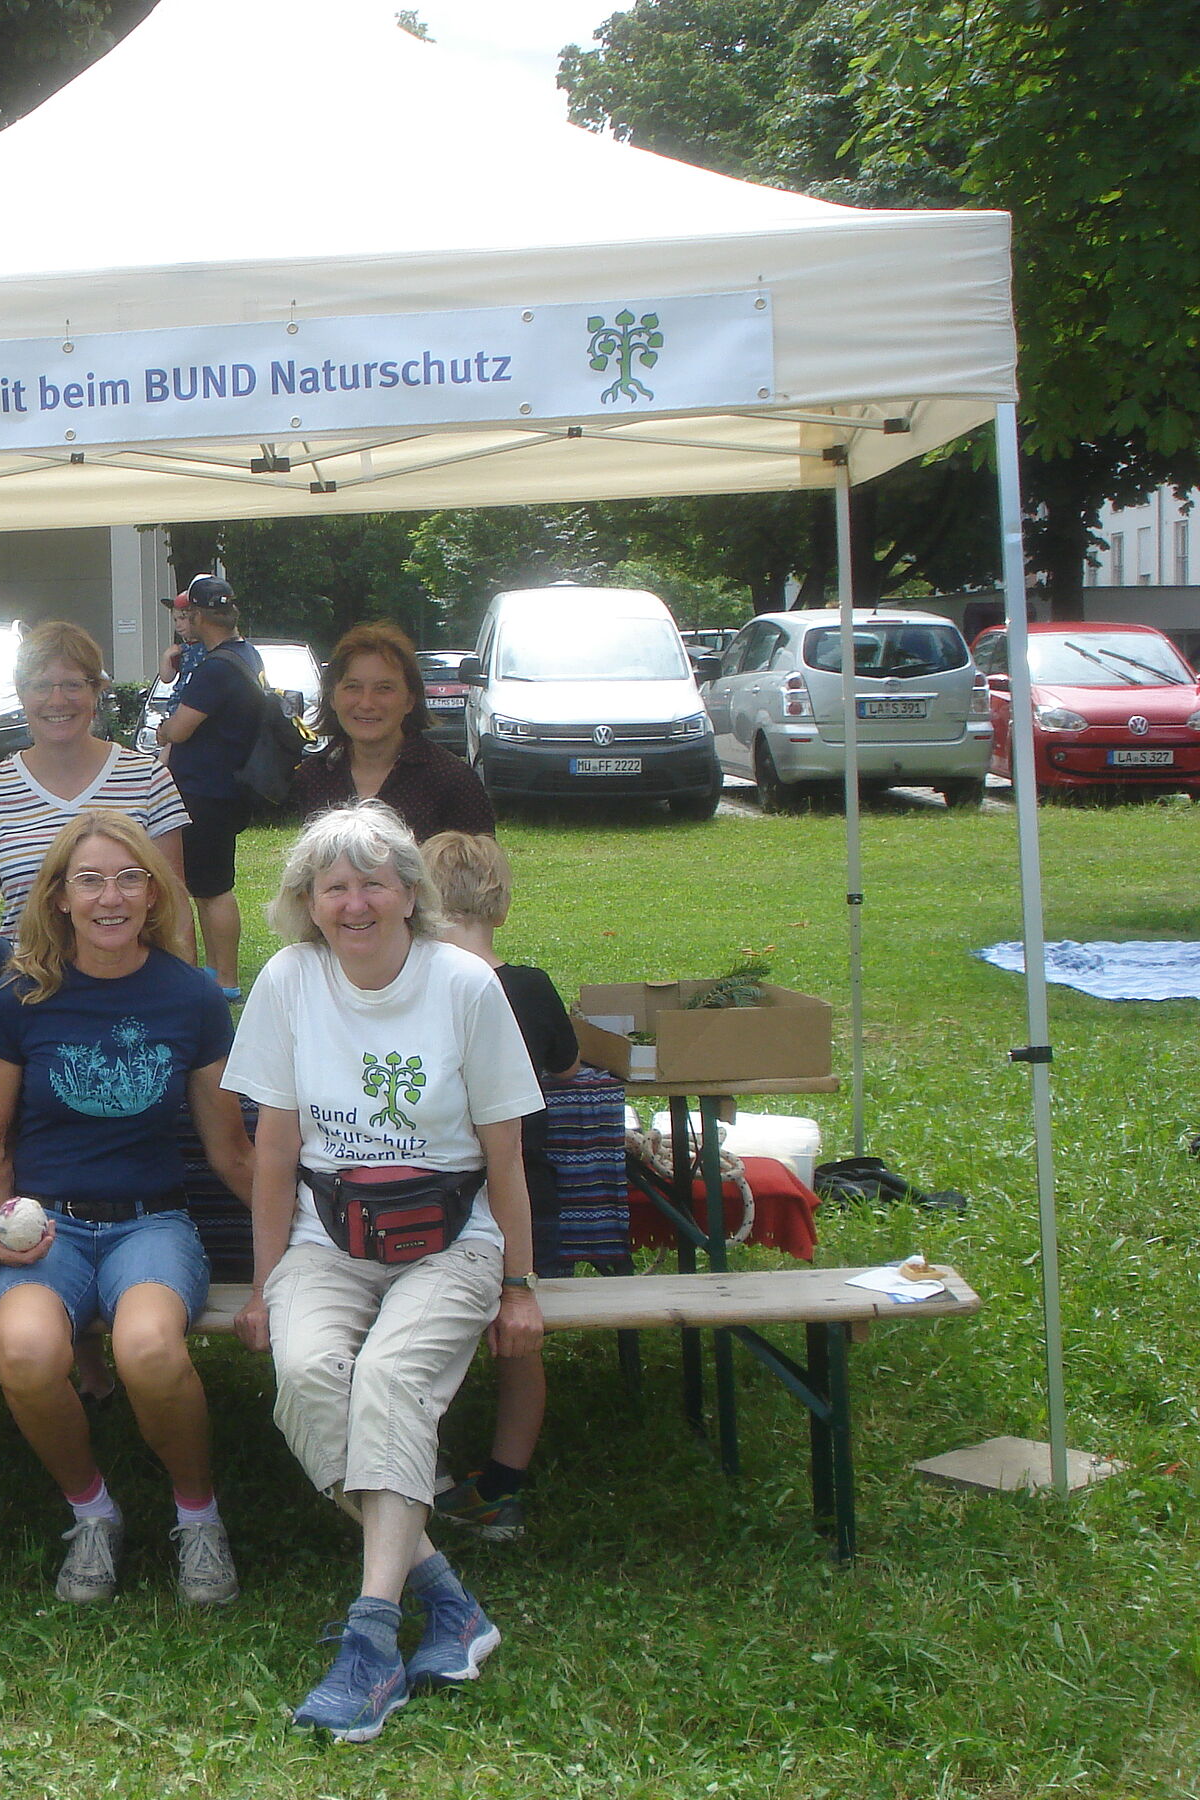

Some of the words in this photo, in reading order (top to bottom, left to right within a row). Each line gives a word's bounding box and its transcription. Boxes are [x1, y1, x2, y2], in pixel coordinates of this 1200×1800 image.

[39, 372, 130, 411] beim
[145, 363, 257, 403] BUND
[271, 350, 512, 396] Naturschutz
[901, 703, 920, 714] 391
[1149, 752, 1169, 763] 327
[599, 760, 612, 771] FF
[614, 760, 640, 771] 2222
[310, 1104, 357, 1125] Bund
[323, 1137, 336, 1155] in
